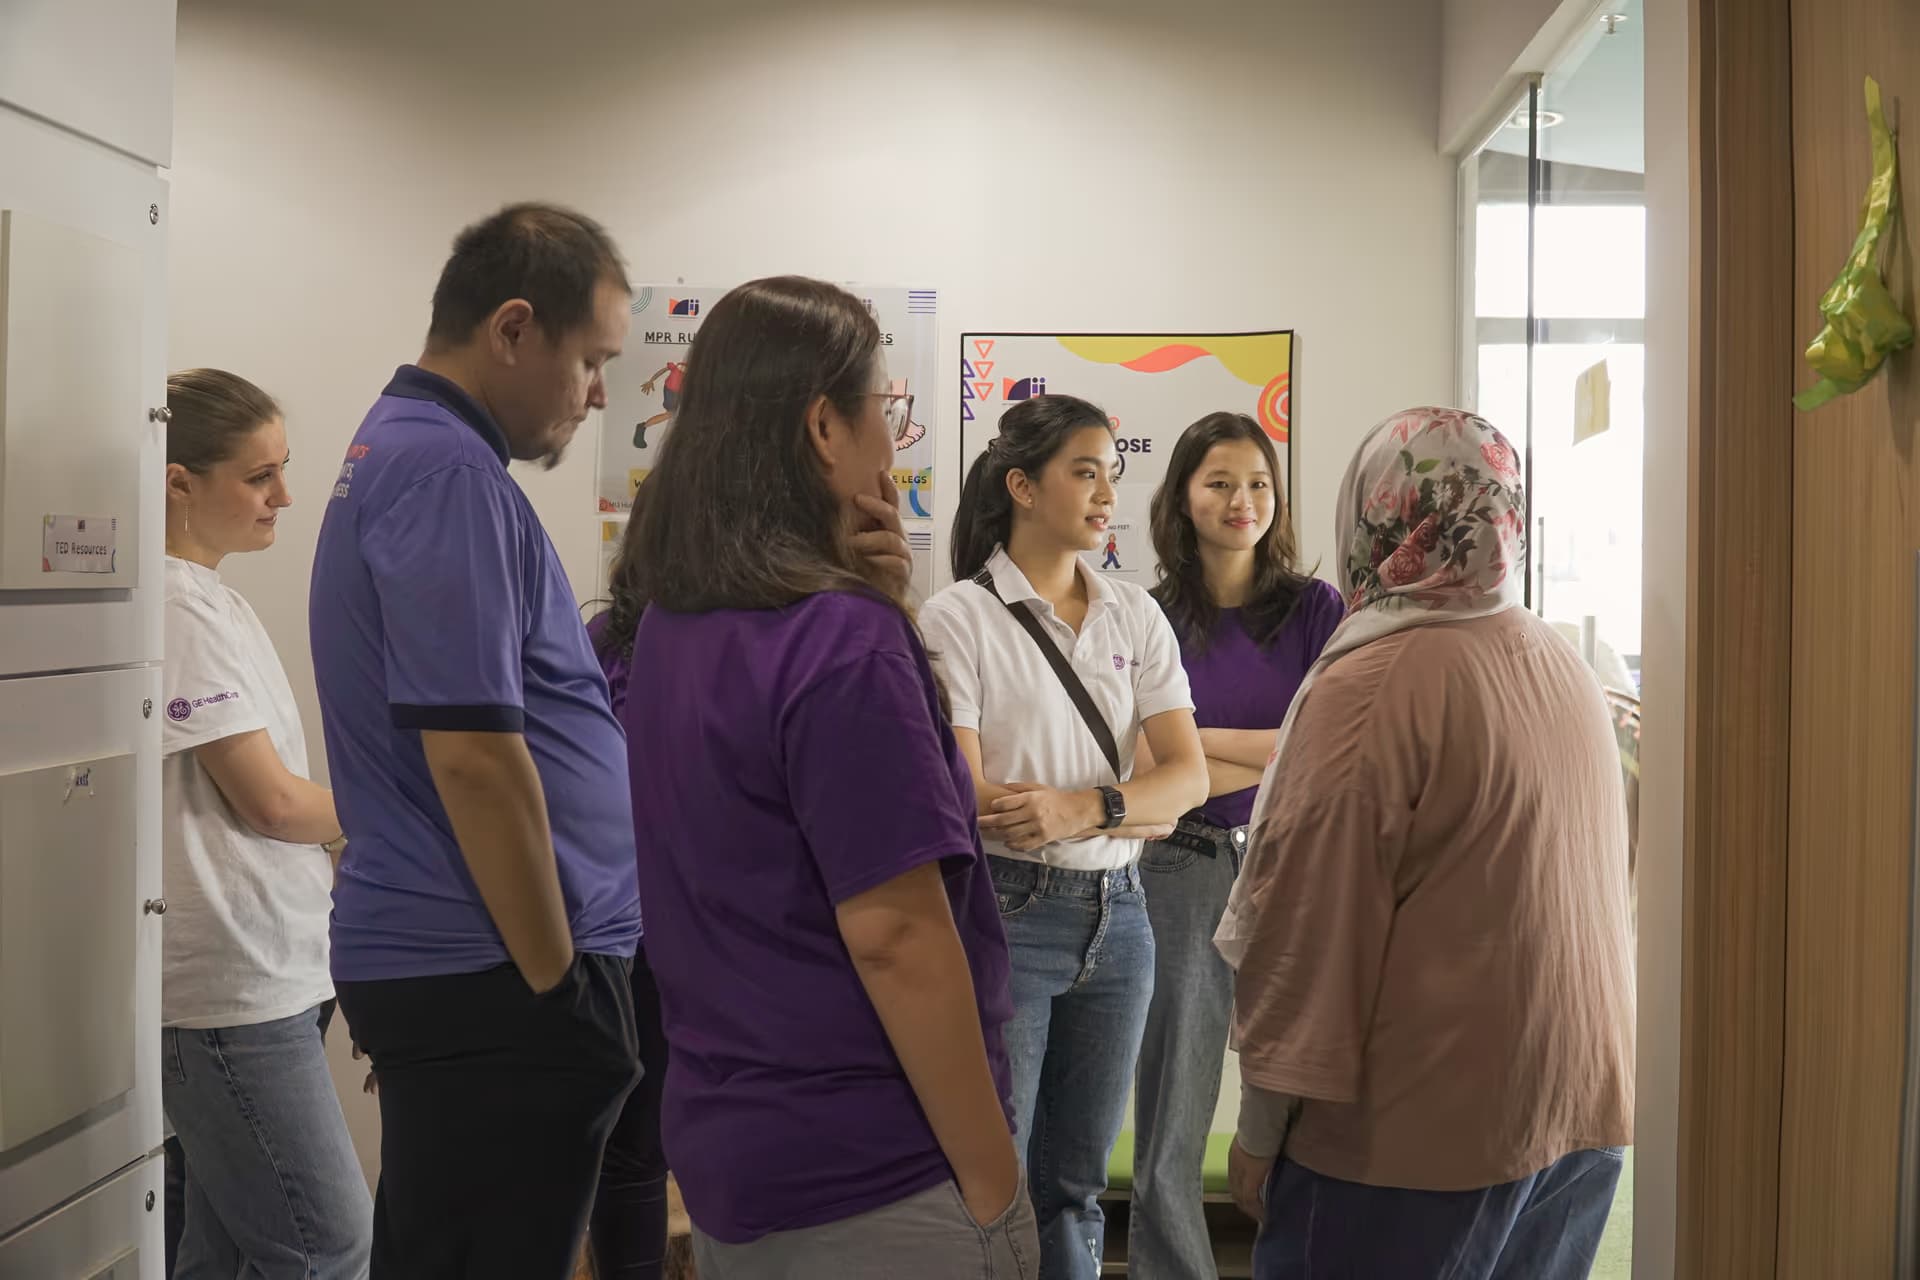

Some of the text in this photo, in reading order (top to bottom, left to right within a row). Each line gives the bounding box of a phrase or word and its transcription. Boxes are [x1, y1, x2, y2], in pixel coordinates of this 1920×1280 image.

[645, 331, 672, 343] MPR
[1116, 438, 1152, 453] OSE
[902, 475, 928, 484] LEGS
[56, 541, 107, 555] TED Resources
[192, 698, 204, 708] GE
